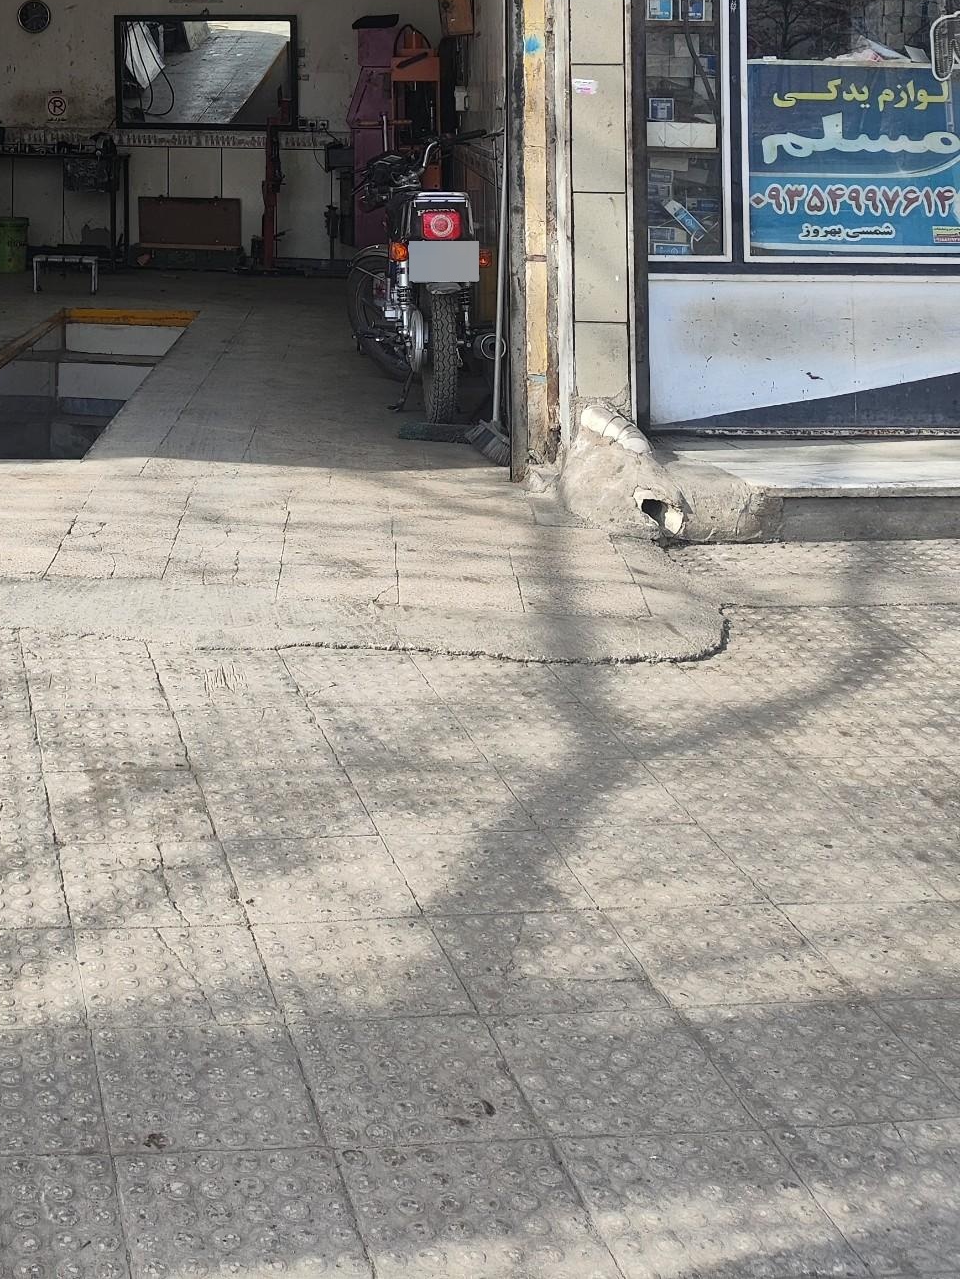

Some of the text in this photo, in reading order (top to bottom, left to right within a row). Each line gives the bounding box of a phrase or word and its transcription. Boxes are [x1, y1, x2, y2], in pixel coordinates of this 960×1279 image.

[773, 78, 949, 112] لوازم یدکی
[762, 111, 960, 164] مسلم
[751, 183, 956, 216] ۰۹۳۵۴۹۹۷۶۱۴
